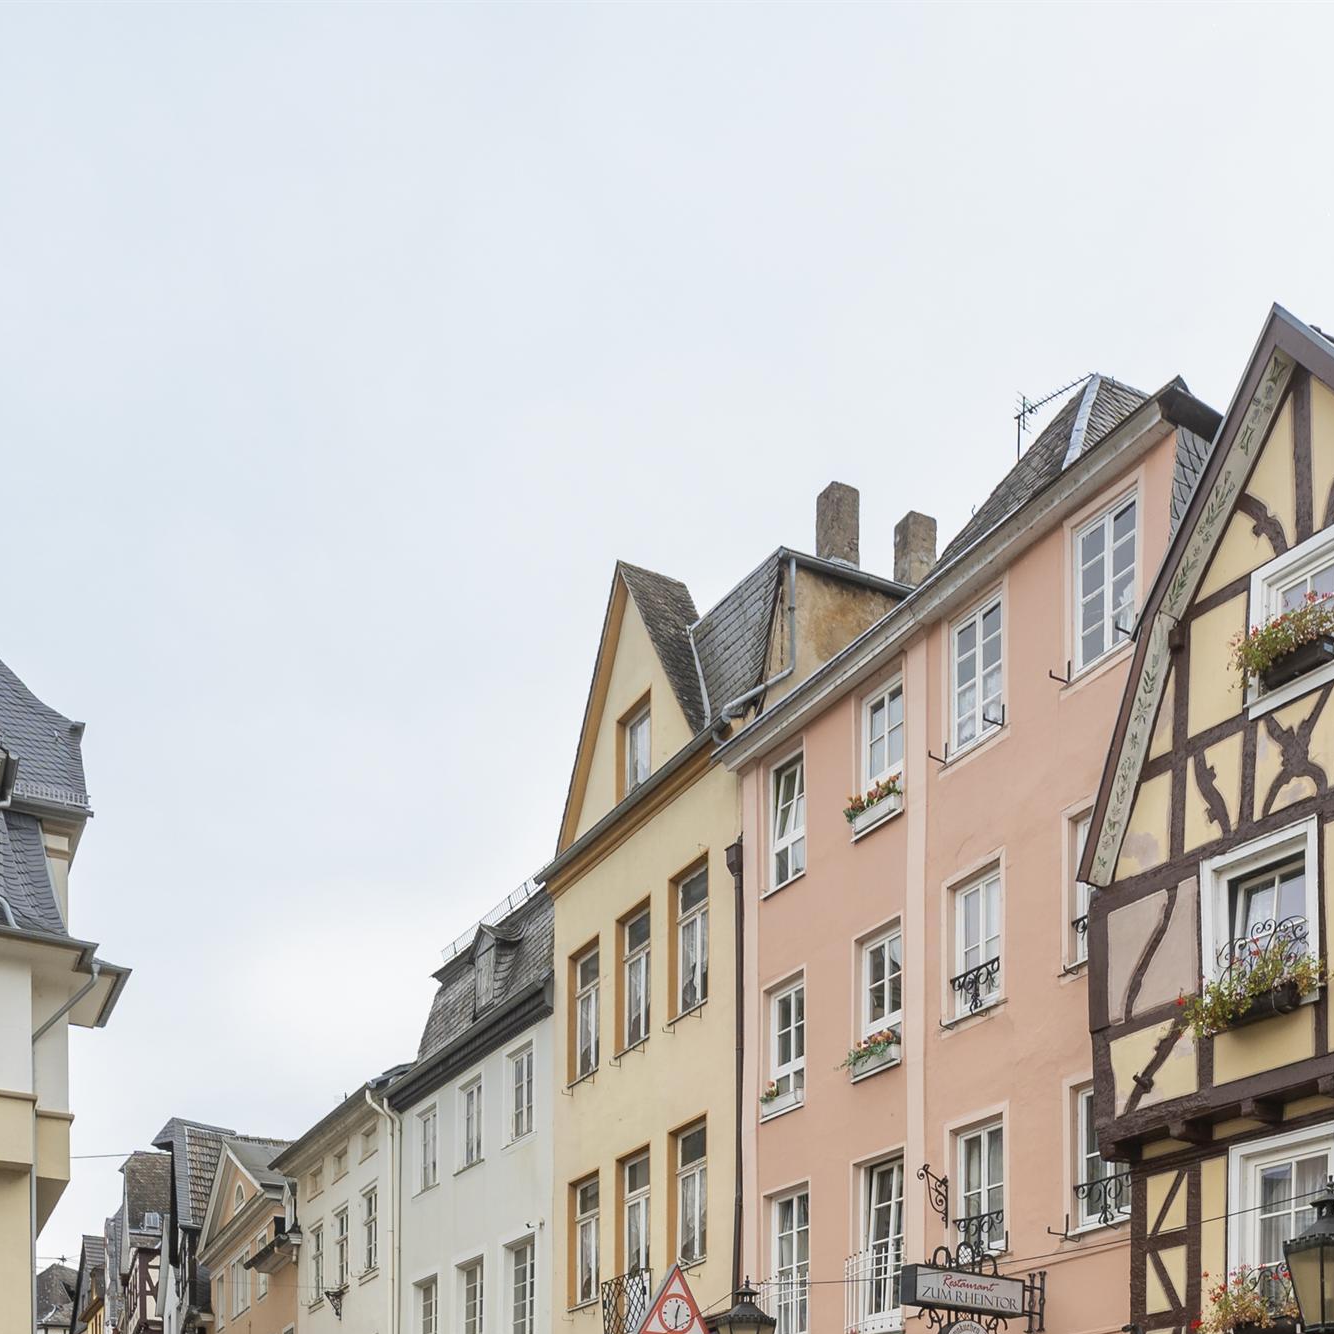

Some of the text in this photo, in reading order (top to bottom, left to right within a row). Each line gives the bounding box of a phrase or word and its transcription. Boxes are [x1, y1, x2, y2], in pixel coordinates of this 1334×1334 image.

[943, 1274, 999, 1292] Restaurant
[922, 1286, 1019, 1311] ZUM RHEINTOR
